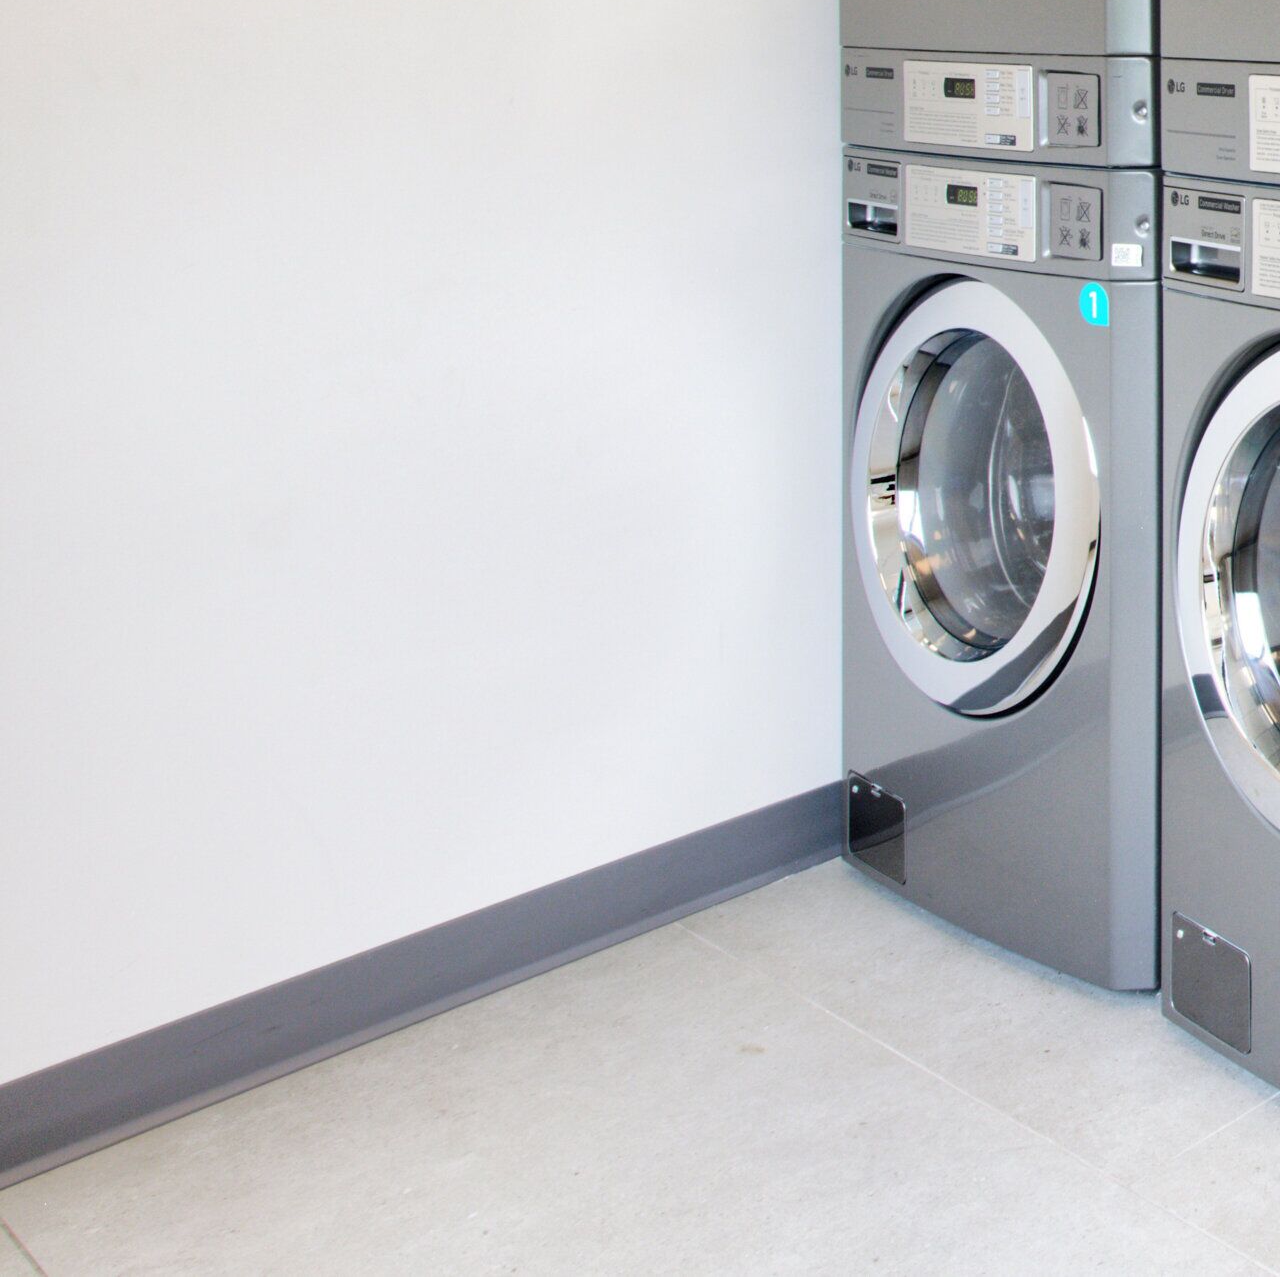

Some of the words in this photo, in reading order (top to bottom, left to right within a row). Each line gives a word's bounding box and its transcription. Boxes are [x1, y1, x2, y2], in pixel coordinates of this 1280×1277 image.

[1176, 82, 1186, 93] LG
[1198, 84, 1222, 94] Commercial
[1180, 195, 1190, 206] LG
[1199, 198, 1224, 210] Commercial
[1224, 201, 1241, 212] Washer
[1201, 229, 1214, 239] Direct
[1214, 230, 1226, 240] Drive
[1089, 291, 1097, 319] 1
